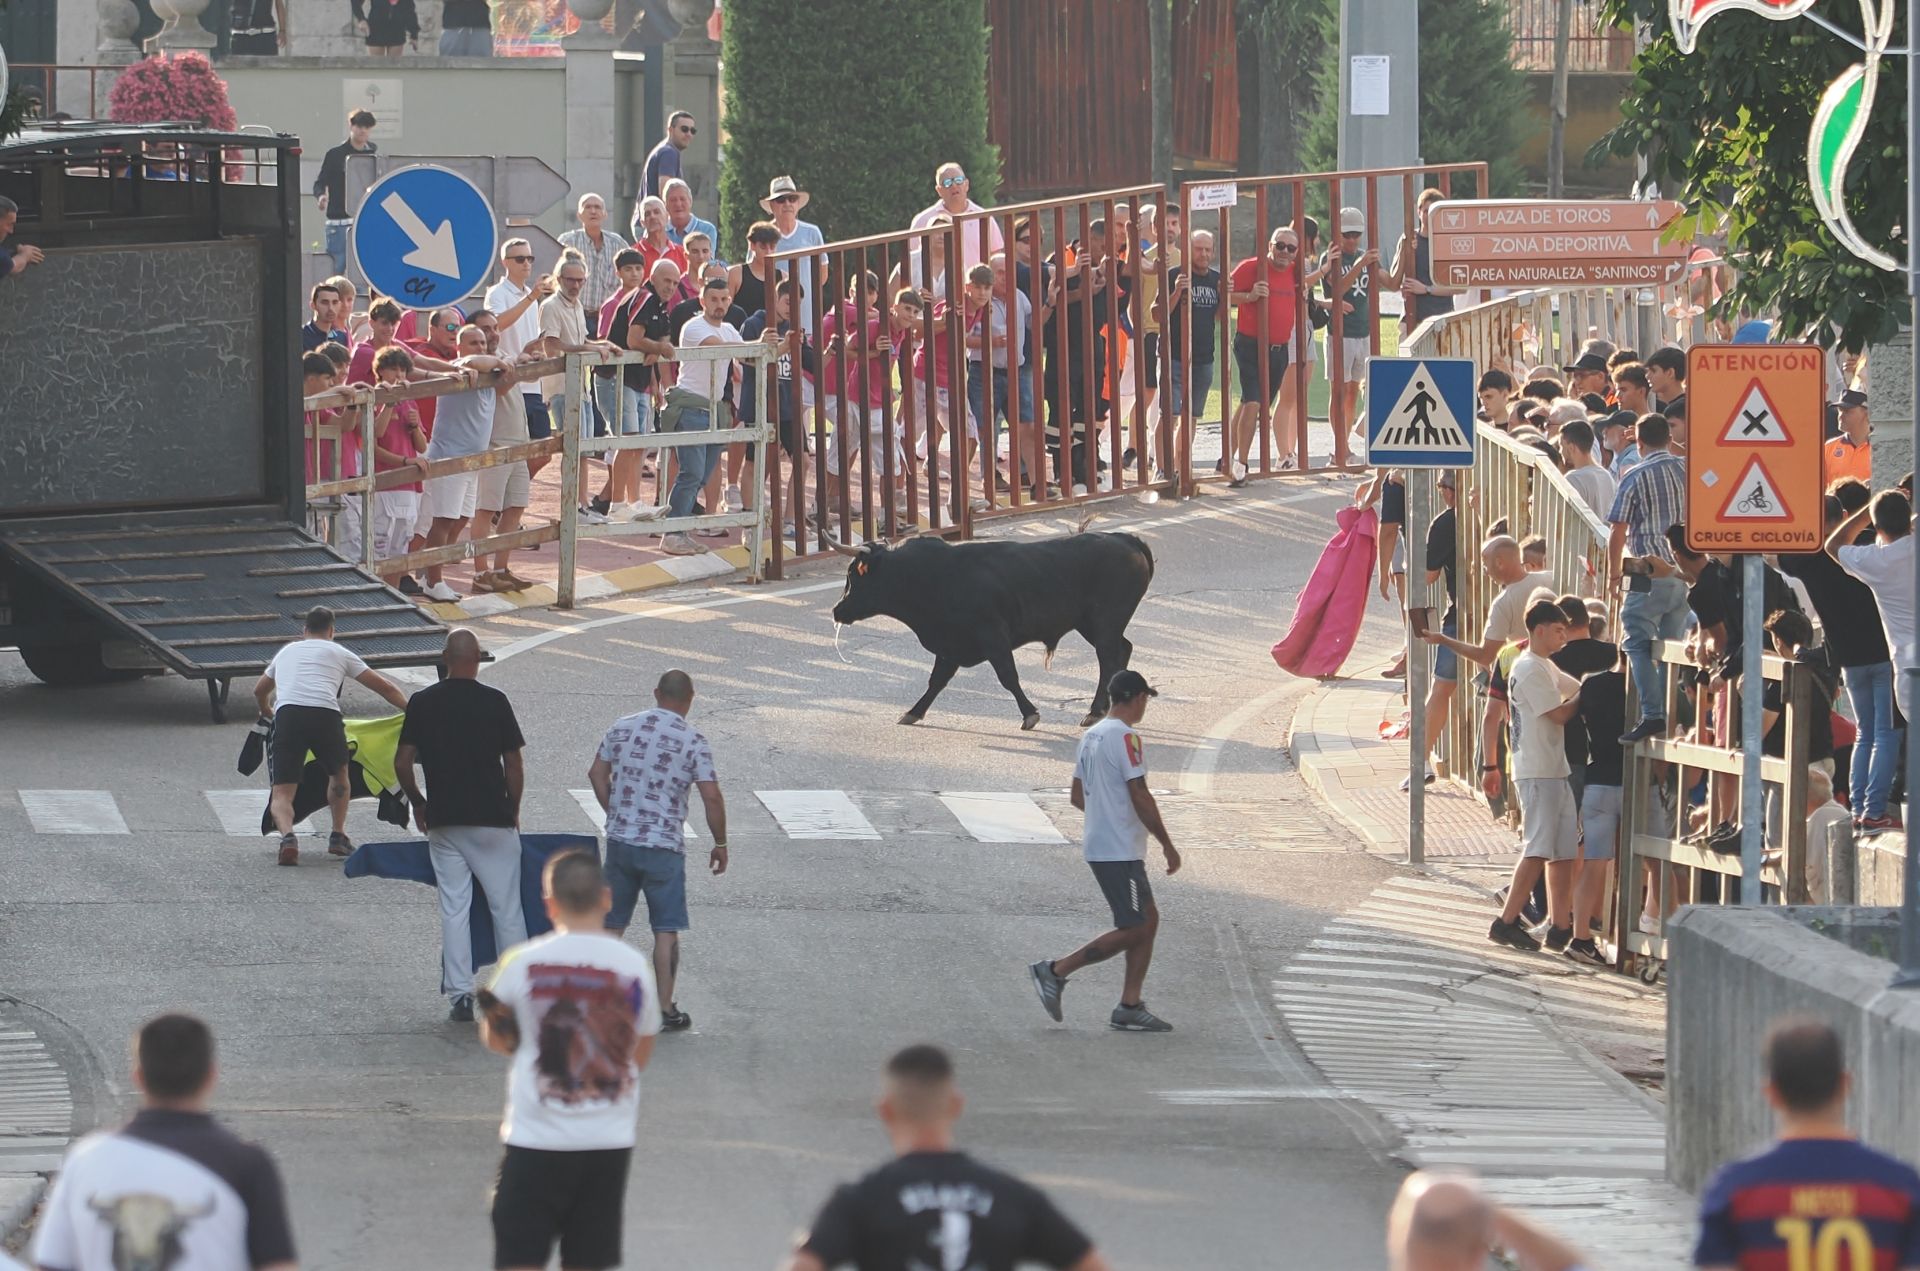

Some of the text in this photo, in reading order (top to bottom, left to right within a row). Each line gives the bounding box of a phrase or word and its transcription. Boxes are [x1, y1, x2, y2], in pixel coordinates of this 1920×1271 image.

[1478, 208, 1611, 225] PLAZA DE TOROS
[1491, 235, 1632, 253] ZONA DEPORTIVA
[1471, 268, 1505, 281] AREA
[1509, 267, 1585, 280] NATURALEZA
[1696, 352, 1816, 371] ATENCIÓN
[1694, 530, 1815, 542] CRUCE CICLOVÍA
